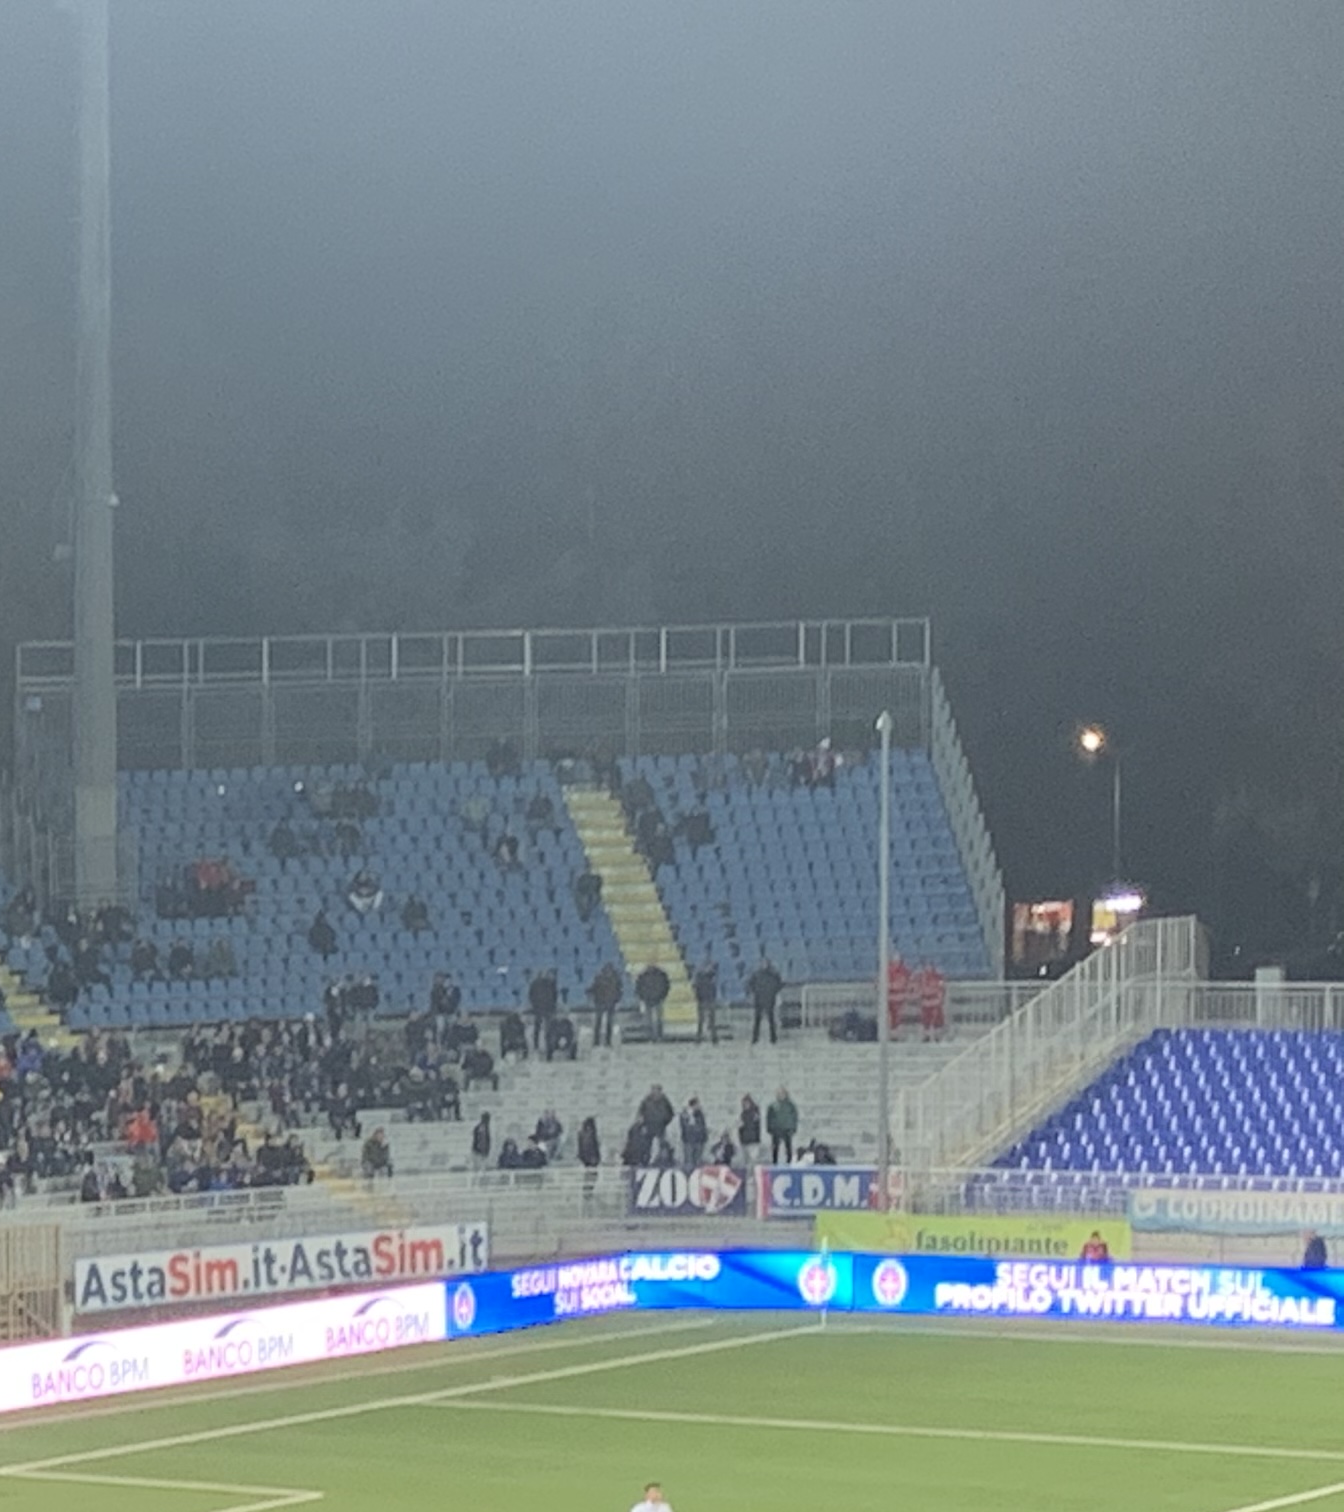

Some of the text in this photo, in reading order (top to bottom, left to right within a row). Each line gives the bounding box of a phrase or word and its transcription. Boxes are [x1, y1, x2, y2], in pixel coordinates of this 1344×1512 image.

[511, 1269, 556, 1299] SEGUI
[619, 1252, 721, 1281] CALCIO
[996, 1262, 1271, 1298] SEGUI IL MATCH SUL
[935, 1282, 1336, 1326] PROFILO TWITTER UFFICIALE
[325, 1312, 430, 1353] BANCO BPM
[183, 1333, 294, 1376] BANCO BPM
[31, 1357, 150, 1400] BANCO BPM
